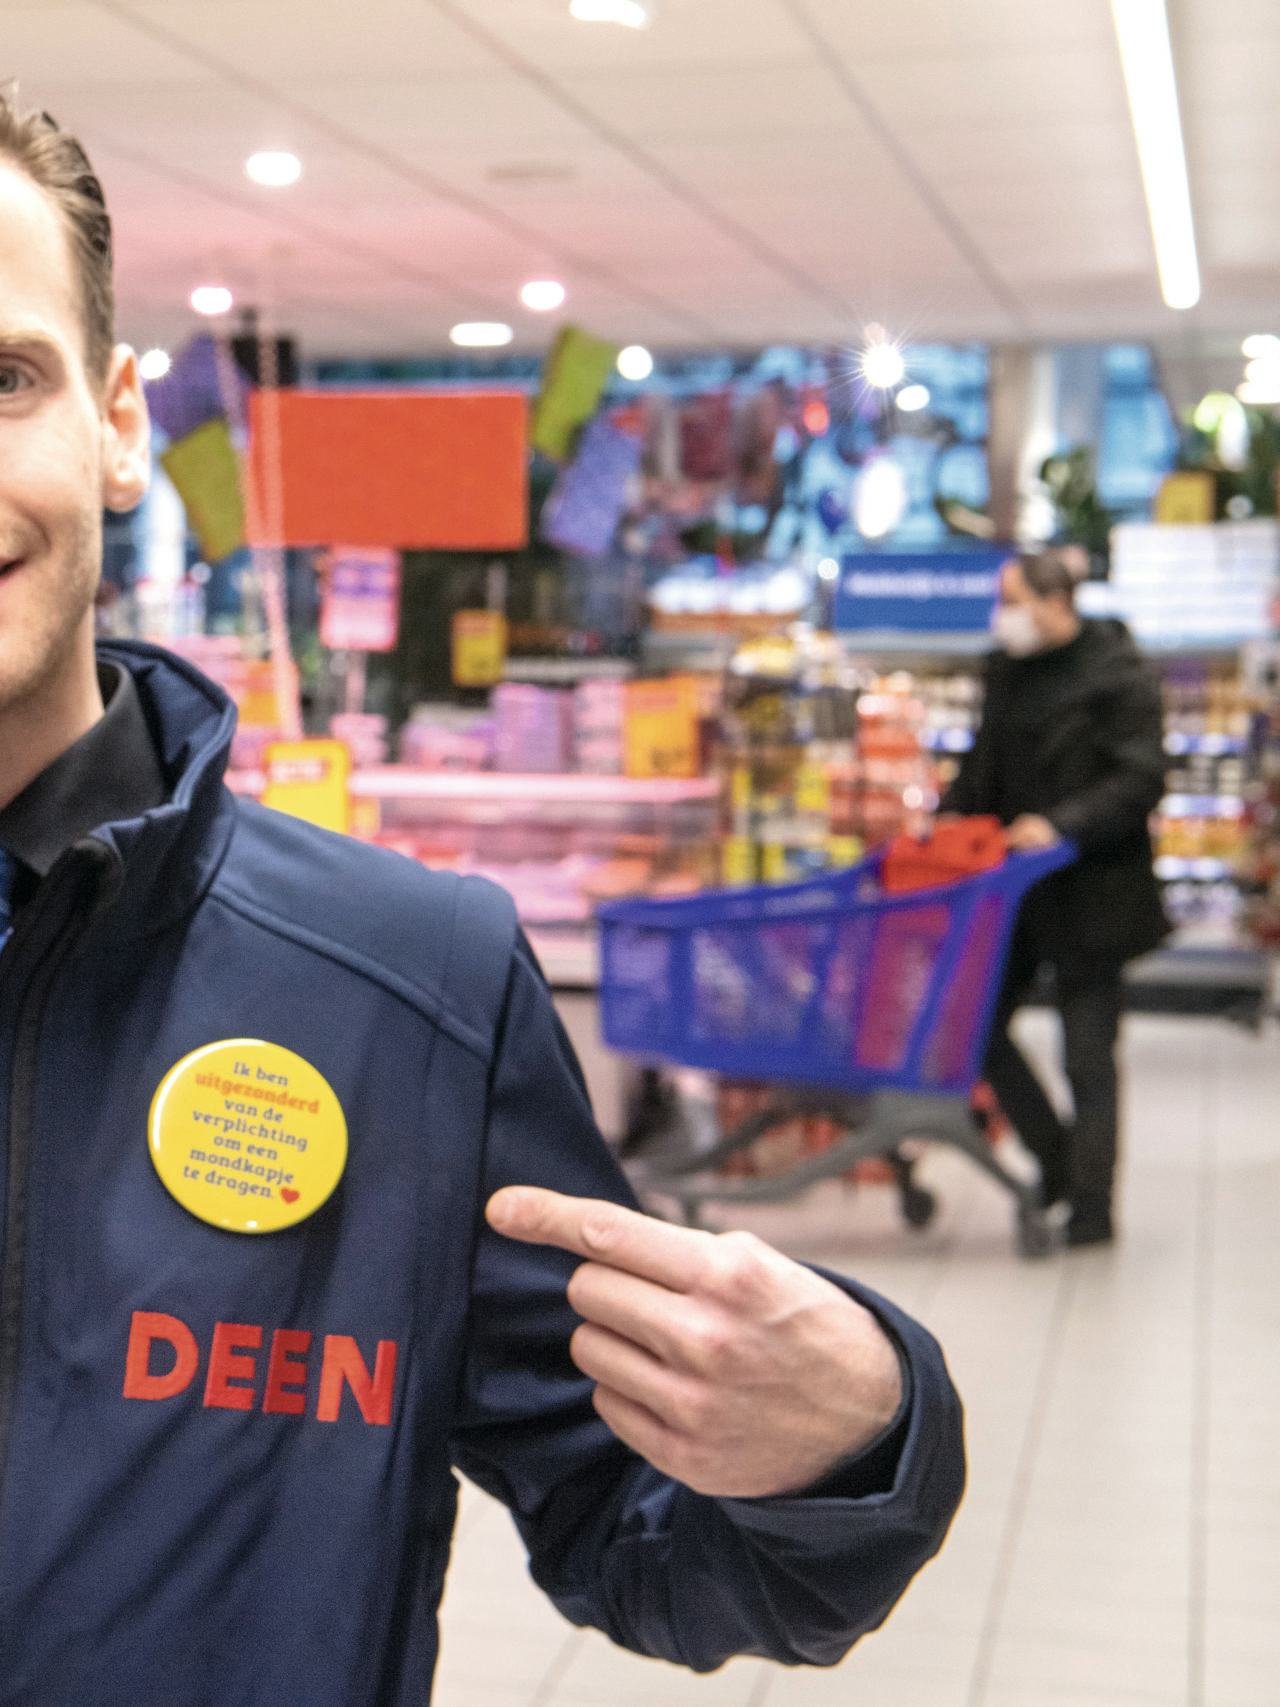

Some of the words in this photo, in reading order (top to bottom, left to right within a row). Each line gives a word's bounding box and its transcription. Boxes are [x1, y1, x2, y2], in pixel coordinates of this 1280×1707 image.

[233, 1062, 249, 1075] Ik
[256, 1067, 288, 1085] ben
[195, 1072, 319, 1113] uitgezonderd
[224, 1098, 257, 1115] van
[263, 1104, 283, 1122] de
[192, 1109, 307, 1151] verplichting
[213, 1134, 240, 1150] om
[246, 1143, 278, 1160] een
[182, 1165, 199, 1180] te
[189, 1148, 294, 1184] mondkapje
[122, 1310, 398, 1425] DEEN
